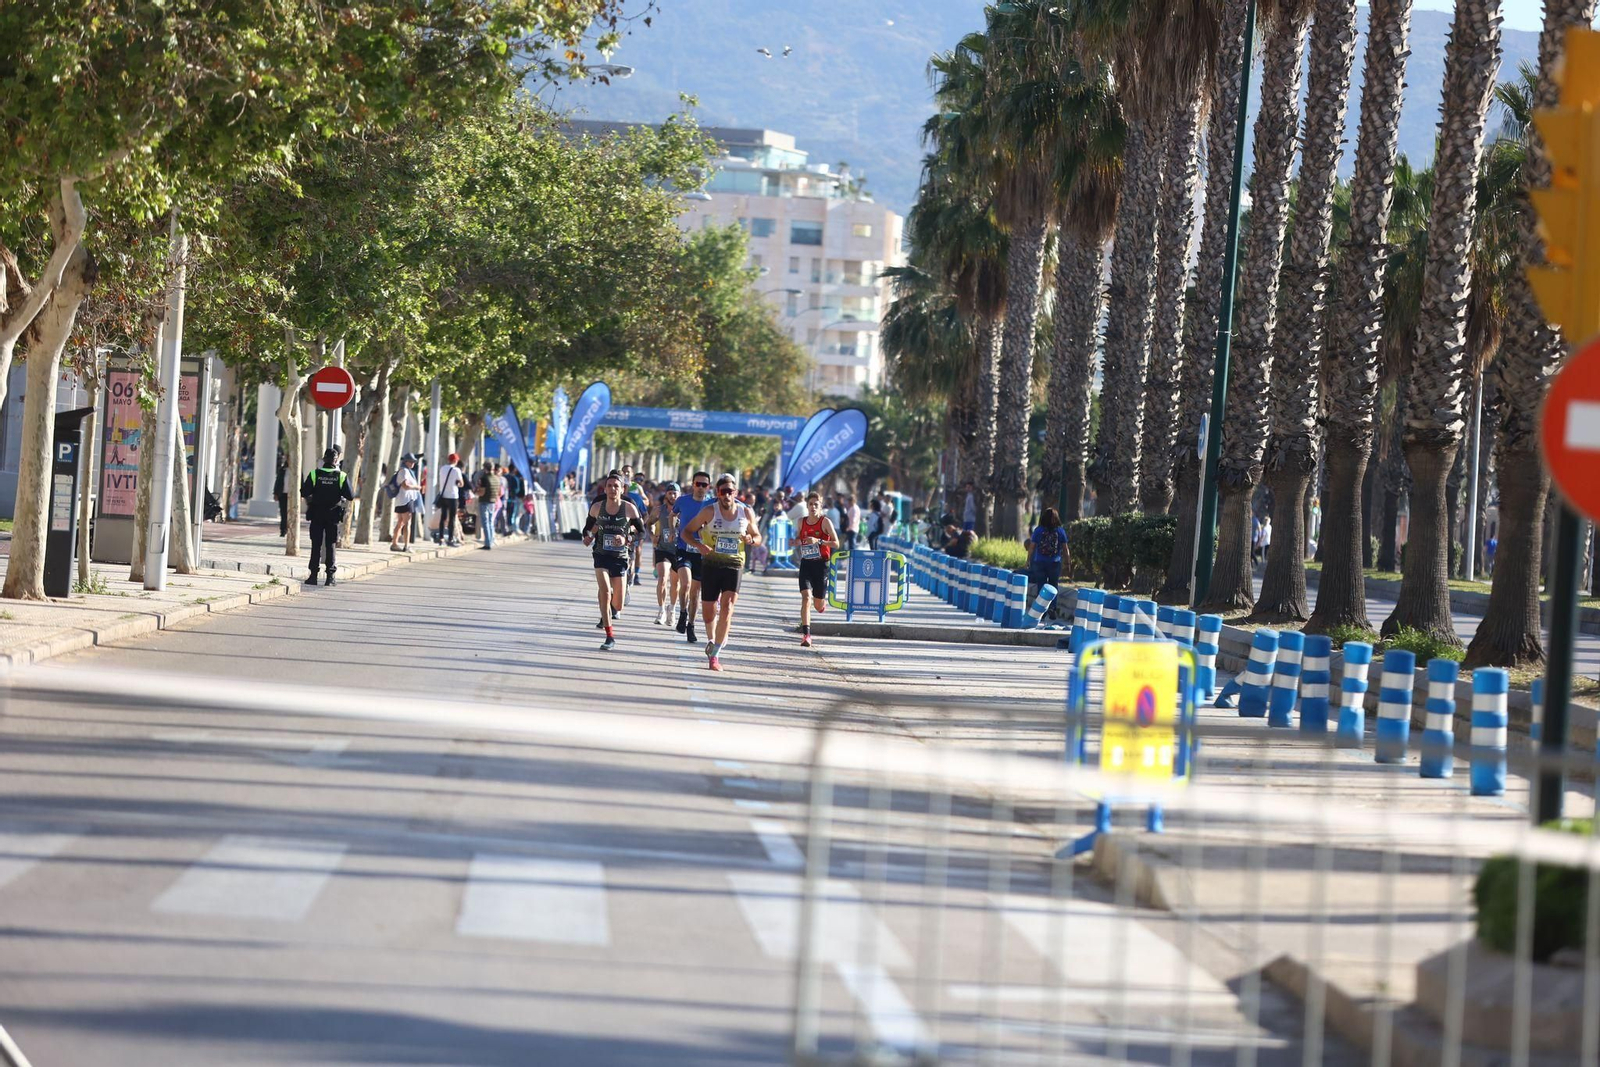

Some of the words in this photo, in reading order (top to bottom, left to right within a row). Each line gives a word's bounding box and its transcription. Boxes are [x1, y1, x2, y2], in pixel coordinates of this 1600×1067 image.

[113, 382, 133, 397] 06
[605, 410, 629, 420] oral
[567, 398, 602, 452] mayoral
[748, 418, 798, 431] mayoral
[58, 443, 72, 459] P
[800, 422, 854, 474] mayoral
